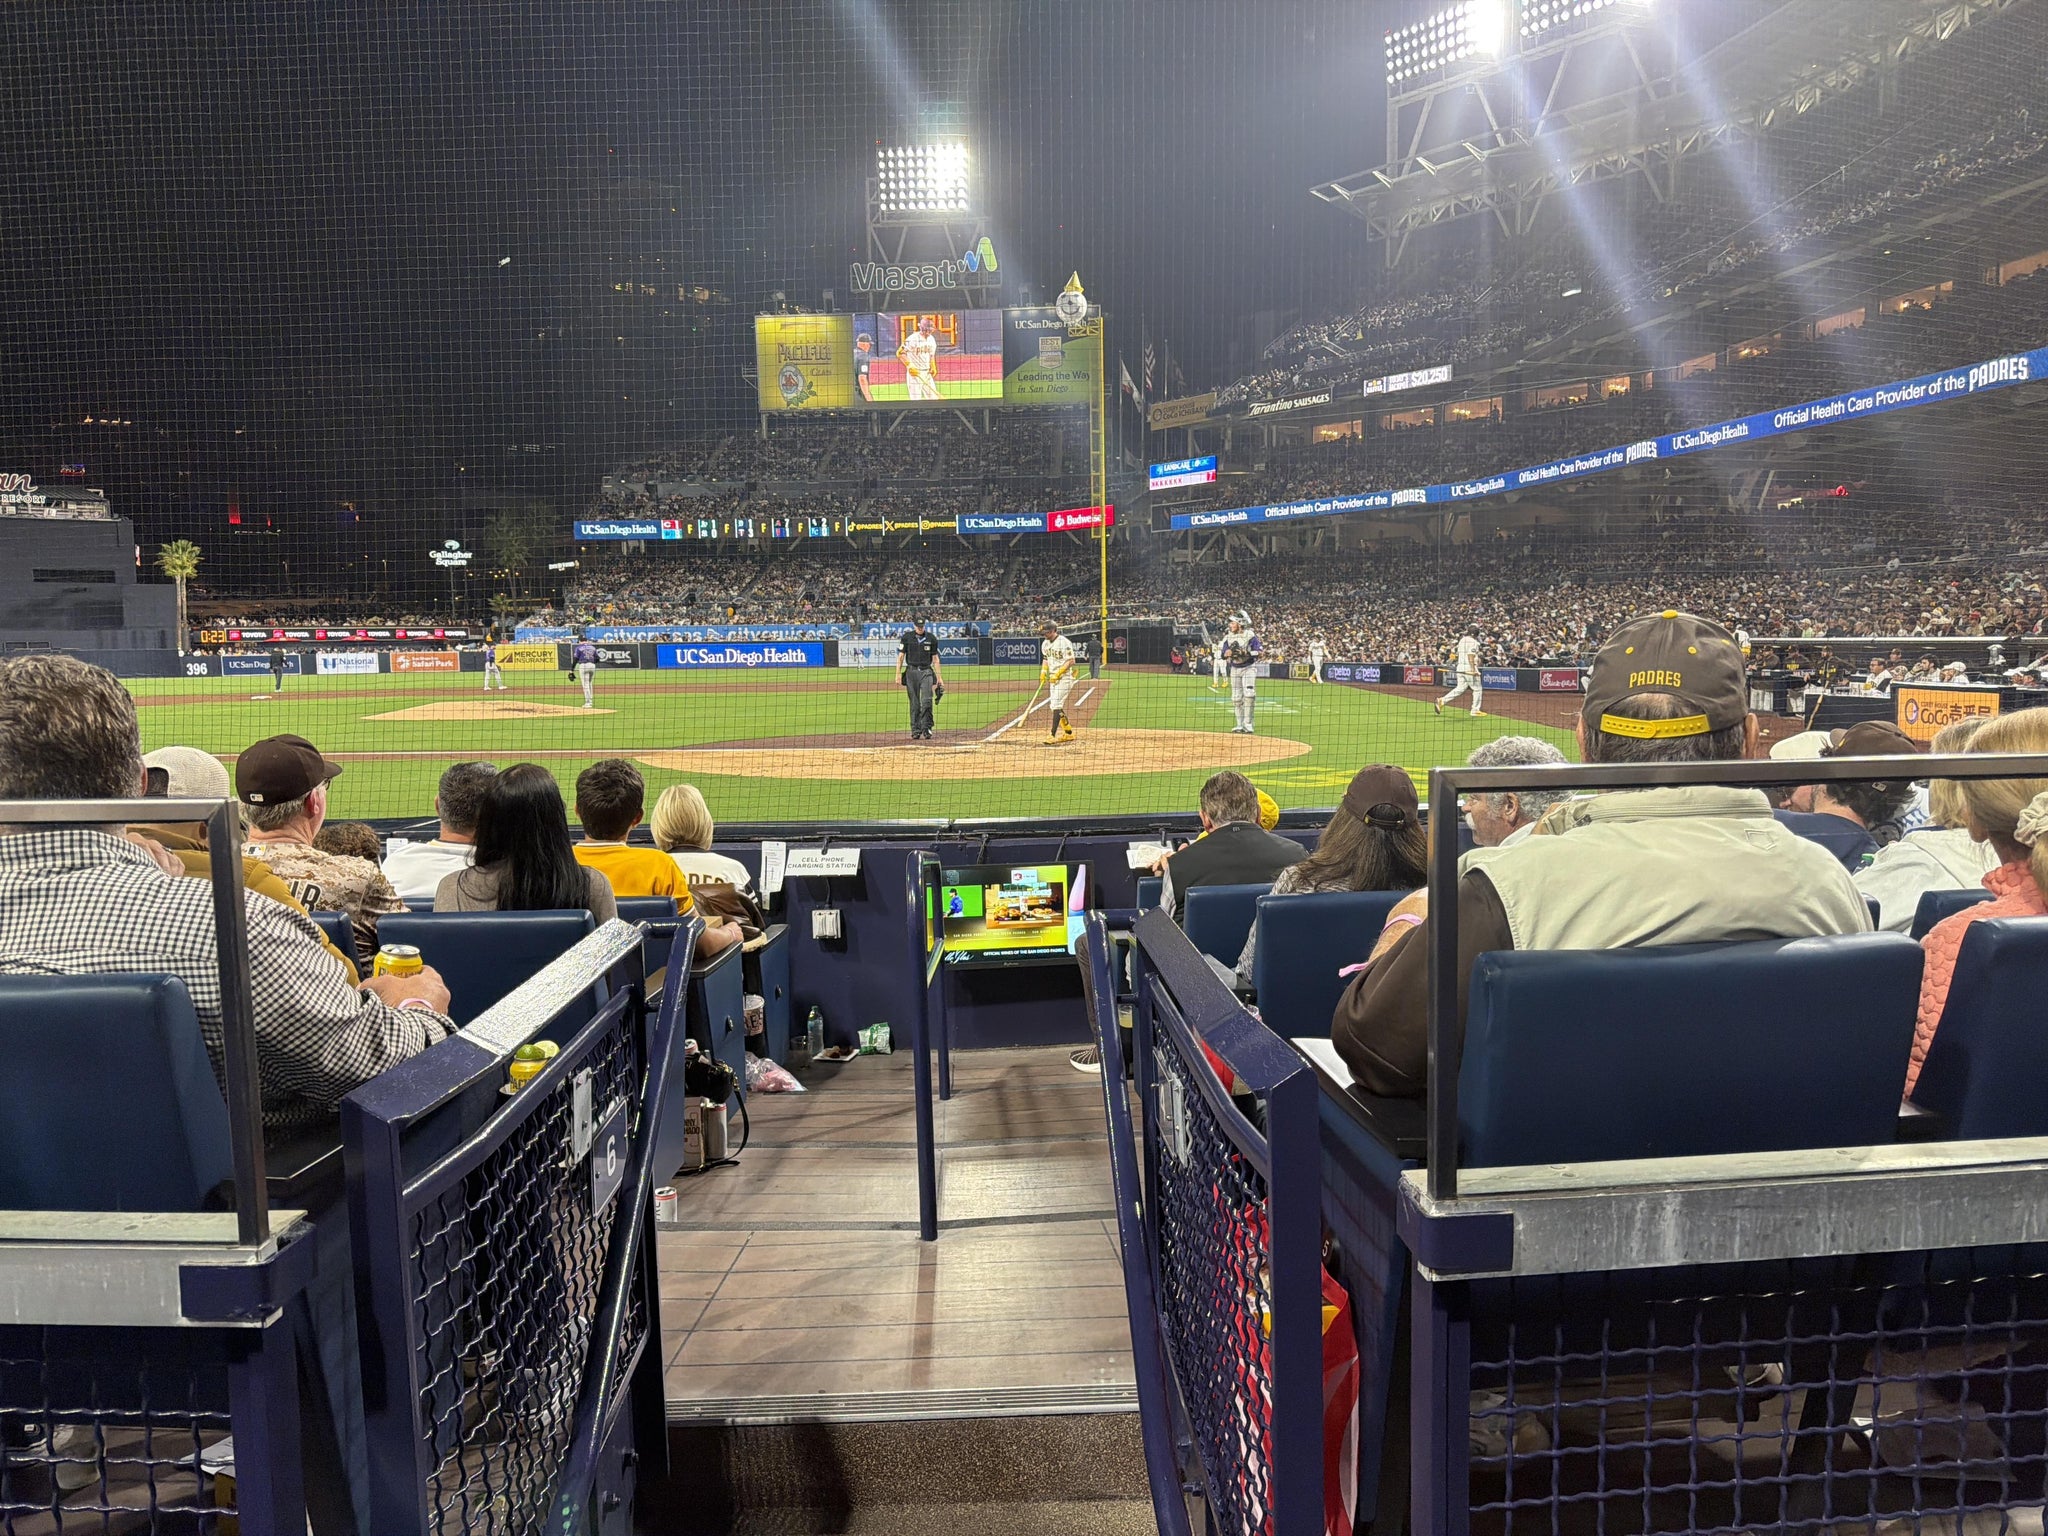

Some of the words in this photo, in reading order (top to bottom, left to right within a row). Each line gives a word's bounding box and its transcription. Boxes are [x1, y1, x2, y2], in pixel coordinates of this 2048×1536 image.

[852, 260, 956, 291] Viasat
[1015, 321, 1027, 329] UC
[1027, 320, 1041, 328] San
[1042, 320, 1063, 329] Diego
[1017, 372, 1054, 382] Leading
[1056, 371, 1070, 379] the
[1029, 385, 1044, 393] San
[1046, 384, 1069, 394] Diego
[1774, 408, 1809, 429] Official
[1811, 400, 1845, 421] Health
[1847, 396, 1873, 412] Care
[1876, 385, 1926, 407] Provider
[1928, 378, 1942, 394] of
[1944, 374, 1966, 391] the
[1968, 357, 2029, 392] PADRES
[1249, 398, 1293, 417] Tarantino
[1294, 393, 1330, 408] SAUSAGES
[1672, 437, 1684, 450] UC
[1684, 434, 1699, 448] San
[1699, 430, 1721, 447] Diego
[1721, 422, 1748, 441] Health
[1519, 469, 1539, 484] Official
[1539, 465, 1559, 479] Health
[1560, 461, 1575, 475] Care
[1575, 456, 1603, 473] Provider
[1603, 453, 1612, 467] of
[1611, 451, 1623, 464] the
[1625, 441, 1658, 464] PADRES
[1451, 484, 1465, 497] UC
[1265, 506, 1289, 518] Official
[1290, 503, 1313, 515] Health
[1314, 501, 1331, 513] Care
[1333, 498, 1363, 510] Provider
[1365, 496, 1374, 506] of
[1374, 495, 1387, 505] the
[1391, 489, 1426, 507] PADRES
[965, 519, 979, 528] UC
[979, 518, 994, 528] San
[994, 518, 1016, 529] Diego
[1016, 518, 1042, 527] Health
[1066, 515, 1102, 525] Budweise
[581, 525, 594, 534] UC
[594, 525, 610, 534] San
[610, 525, 632, 536] Diego
[632, 525, 657, 534] Health
[429, 551, 472, 559] Gallagher
[436, 558, 467, 567] Square
[874, 648, 896, 656] blue
[1007, 642, 1036, 658] petco
[339, 657, 374, 666] National
[676, 649, 698, 664] UC
[699, 649, 724, 664] San
[725, 648, 763, 666] Diego
[763, 648, 806, 663] Health
[186, 663, 208, 675] 396
[254, 661, 271, 669] Dieg
[1335, 667, 1351, 678] petco
[1362, 666, 1380, 678] petco
[1629, 670, 1681, 688] PADRES
[1921, 708, 1949, 726] CoCo
[607, 1135, 616, 1177] 6
[1322, 1240, 1330, 1257] 5
